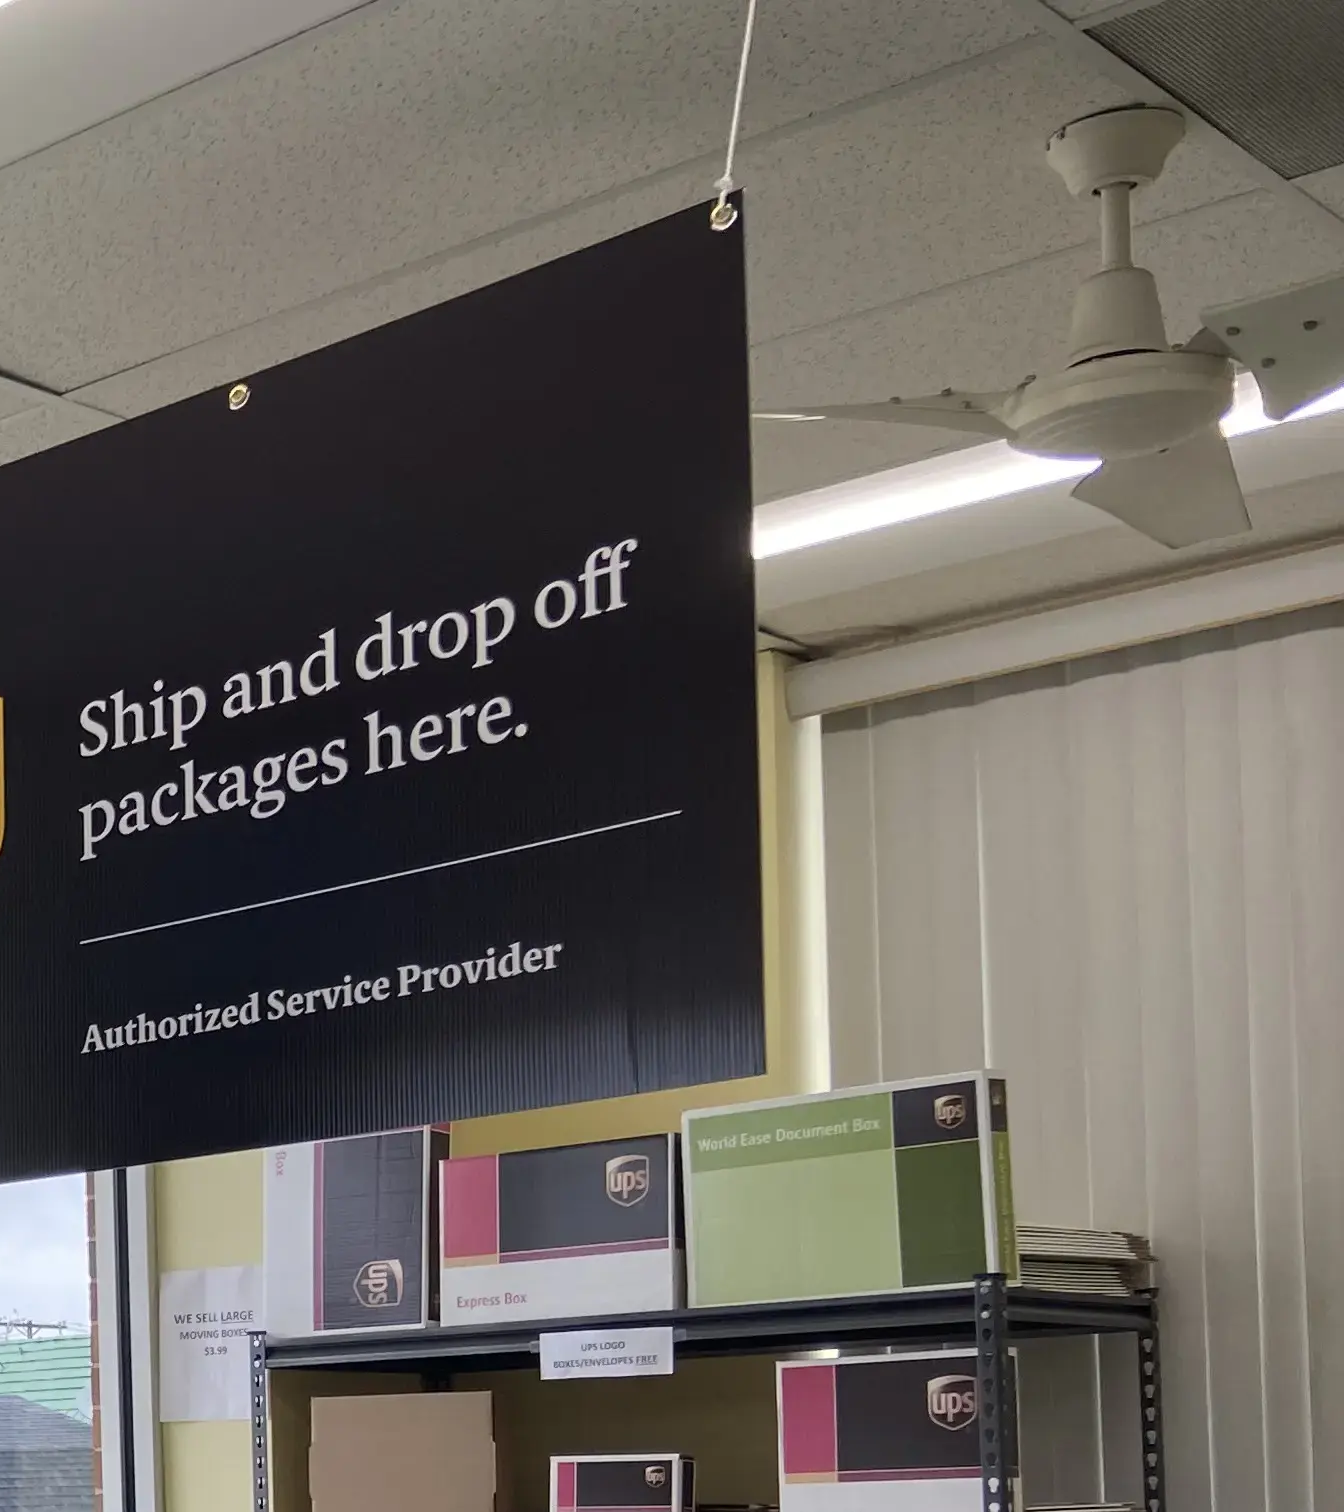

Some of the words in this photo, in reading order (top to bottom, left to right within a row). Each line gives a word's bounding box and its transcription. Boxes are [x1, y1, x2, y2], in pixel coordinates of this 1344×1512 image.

[79, 675, 207, 759] Ship
[222, 628, 339, 724] and
[355, 592, 516, 685] drop
[533, 537, 637, 631] off
[79, 732, 348, 860] packages
[363, 693, 529, 777] here.
[80, 990, 262, 1055] Authorized
[267, 967, 391, 1023] Service
[397, 940, 563, 998] Provider
[697, 1135, 736, 1152] World
[741, 1131, 770, 1147] Ease
[776, 1121, 848, 1142] Document
[853, 1117, 881, 1132] Box
[610, 1170, 646, 1199] ups
[457, 1295, 501, 1309] Express
[504, 1292, 527, 1304] Box
[174, 1314, 193, 1324] WE
[196, 1313, 218, 1322] SELL
[221, 1310, 253, 1321] LARGE
[180, 1330, 219, 1340] MOVING
[222, 1329, 249, 1337] BOXES
[581, 1343, 597, 1351] UPS
[599, 1341, 625, 1350] LOGO
[204, 1346, 227, 1356] $3.99
[553, 1356, 633, 1369] BOXES/ENVELOPES
[636, 1355, 658, 1365] FREE
[933, 1387, 974, 1422] ups
